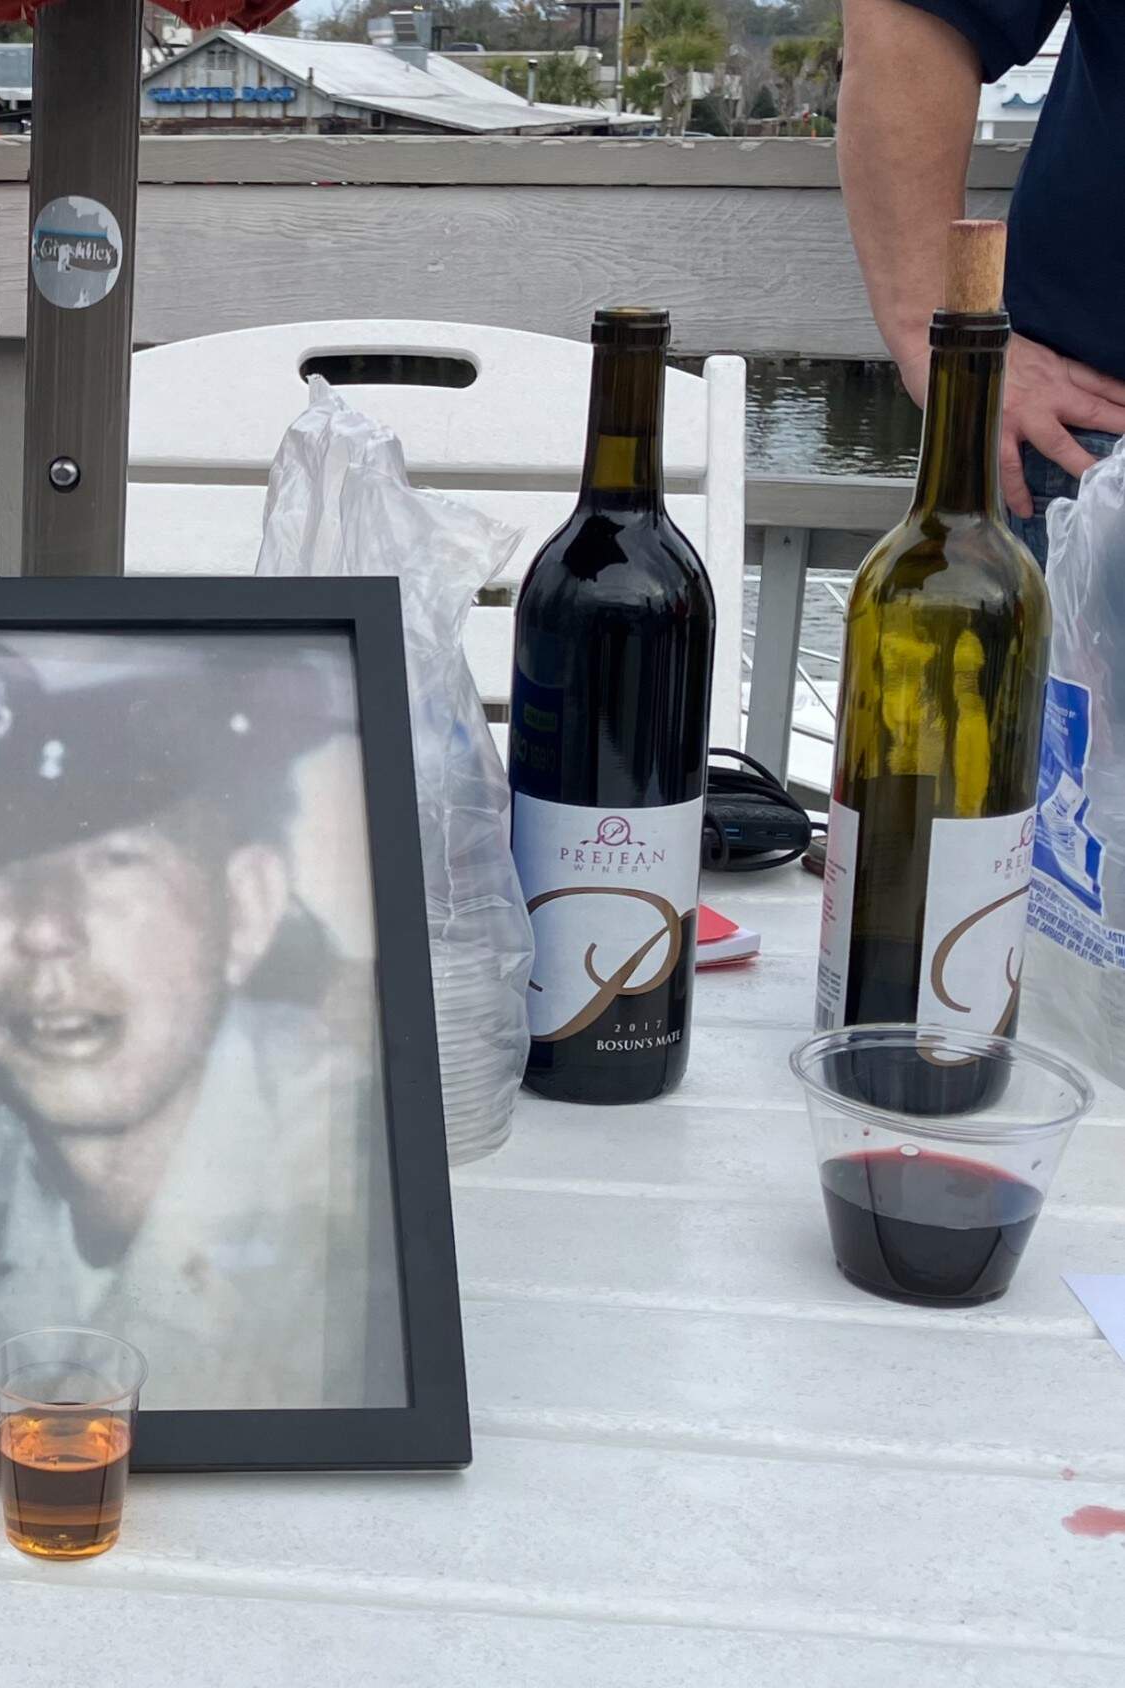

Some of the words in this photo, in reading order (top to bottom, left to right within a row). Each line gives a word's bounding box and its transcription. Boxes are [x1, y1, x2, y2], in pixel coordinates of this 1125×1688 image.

[560, 847, 666, 865] PREJEAN
[574, 864, 652, 874] WINERY
[596, 1037, 653, 1051] BOSUN'S
[655, 1029, 681, 1047] MATE
